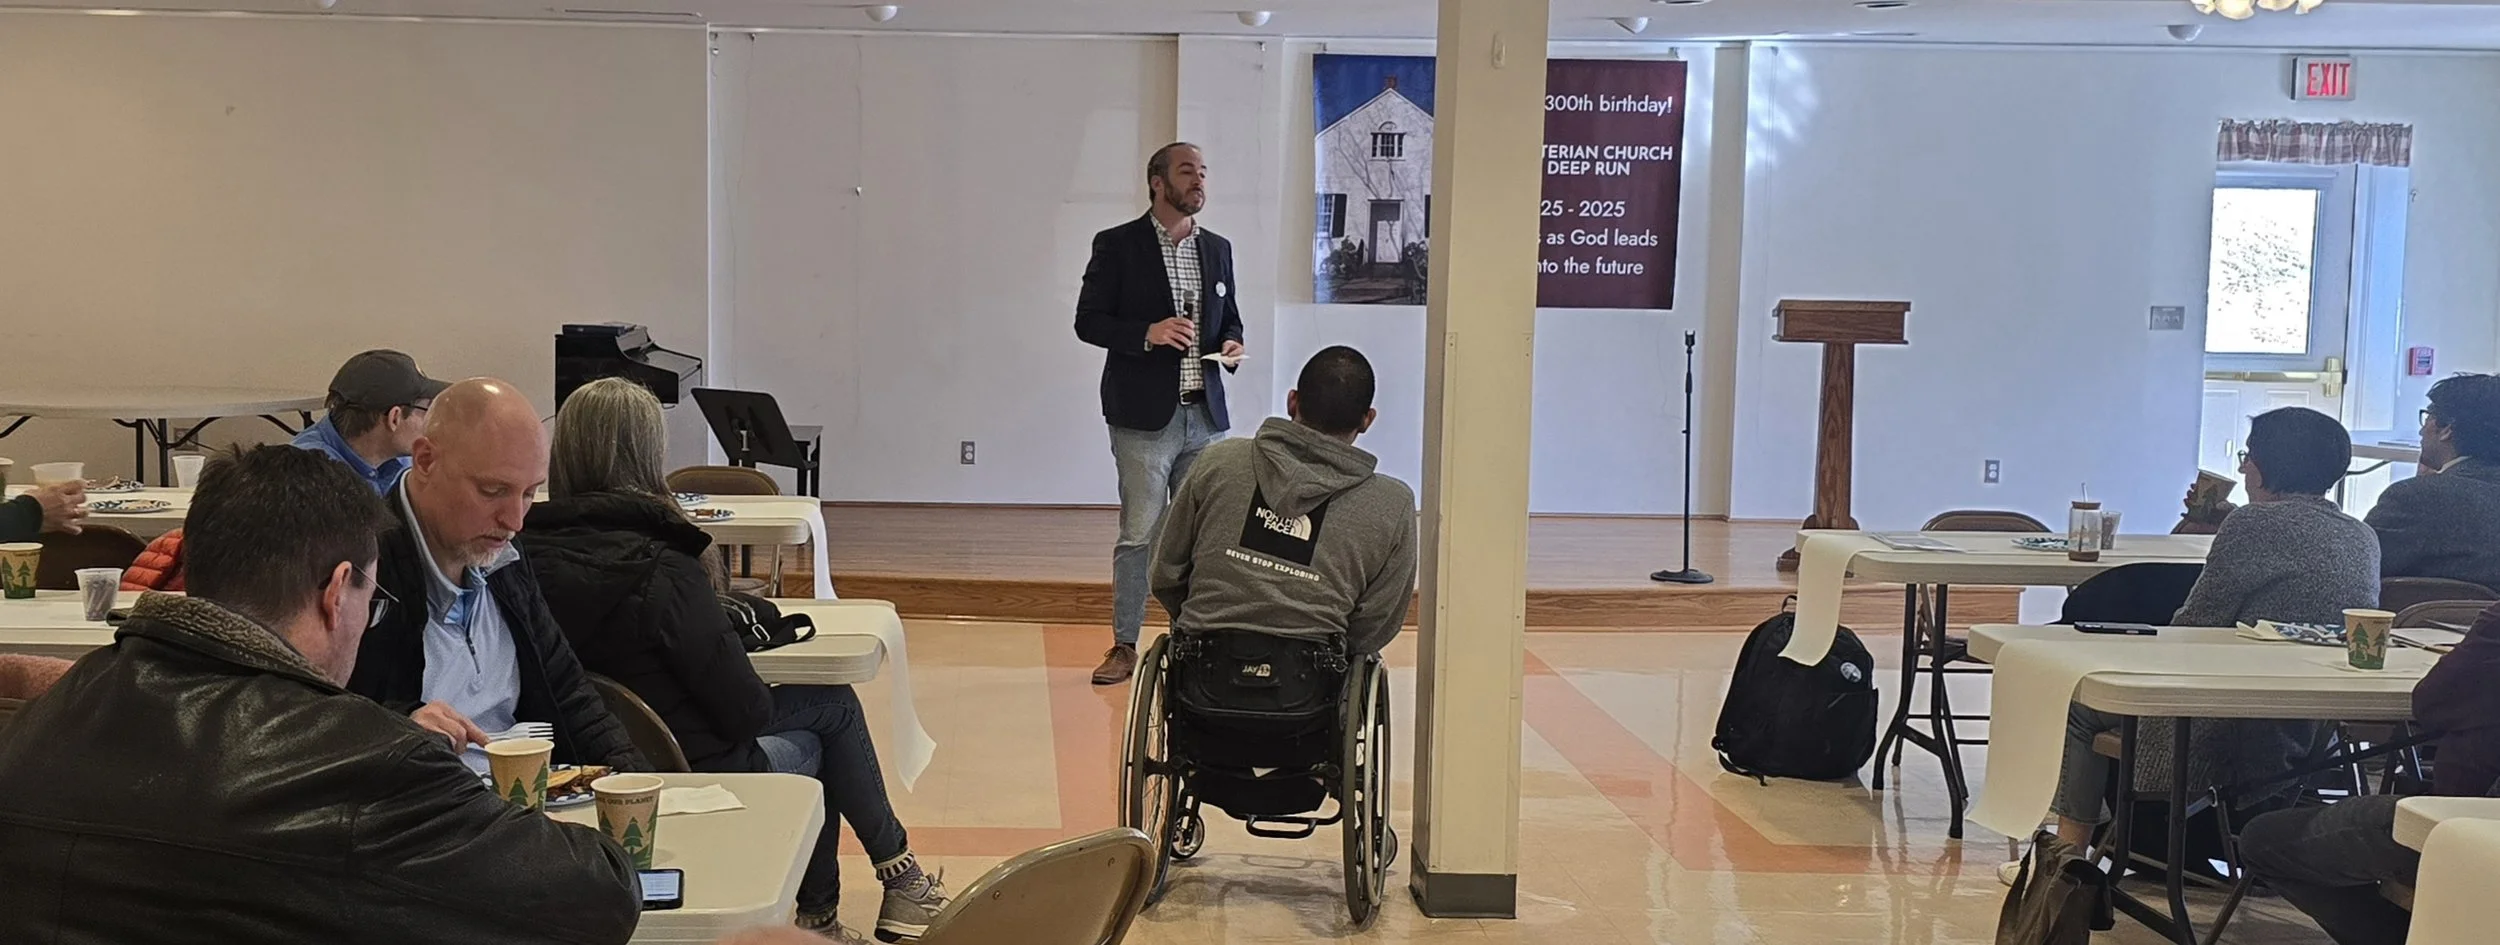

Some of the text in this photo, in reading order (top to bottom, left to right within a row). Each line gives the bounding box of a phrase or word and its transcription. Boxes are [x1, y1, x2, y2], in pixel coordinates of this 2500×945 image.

[2306, 63, 2351, 96] EXIT
[1544, 94, 1673, 116] 300th birthday!
[1603, 146, 1673, 160] CHURCH
[1547, 161, 1630, 175] DEEP RUN
[1579, 200, 1625, 217] 2025
[1546, 233, 1565, 245] as
[1570, 228, 1608, 245] God
[1614, 228, 1658, 247] leads
[1563, 256, 1590, 274] the
[1596, 256, 1644, 274] future
[1263, 519, 1292, 535] FACE
[1225, 548, 1320, 581] NEVER STOP EXPLORING
